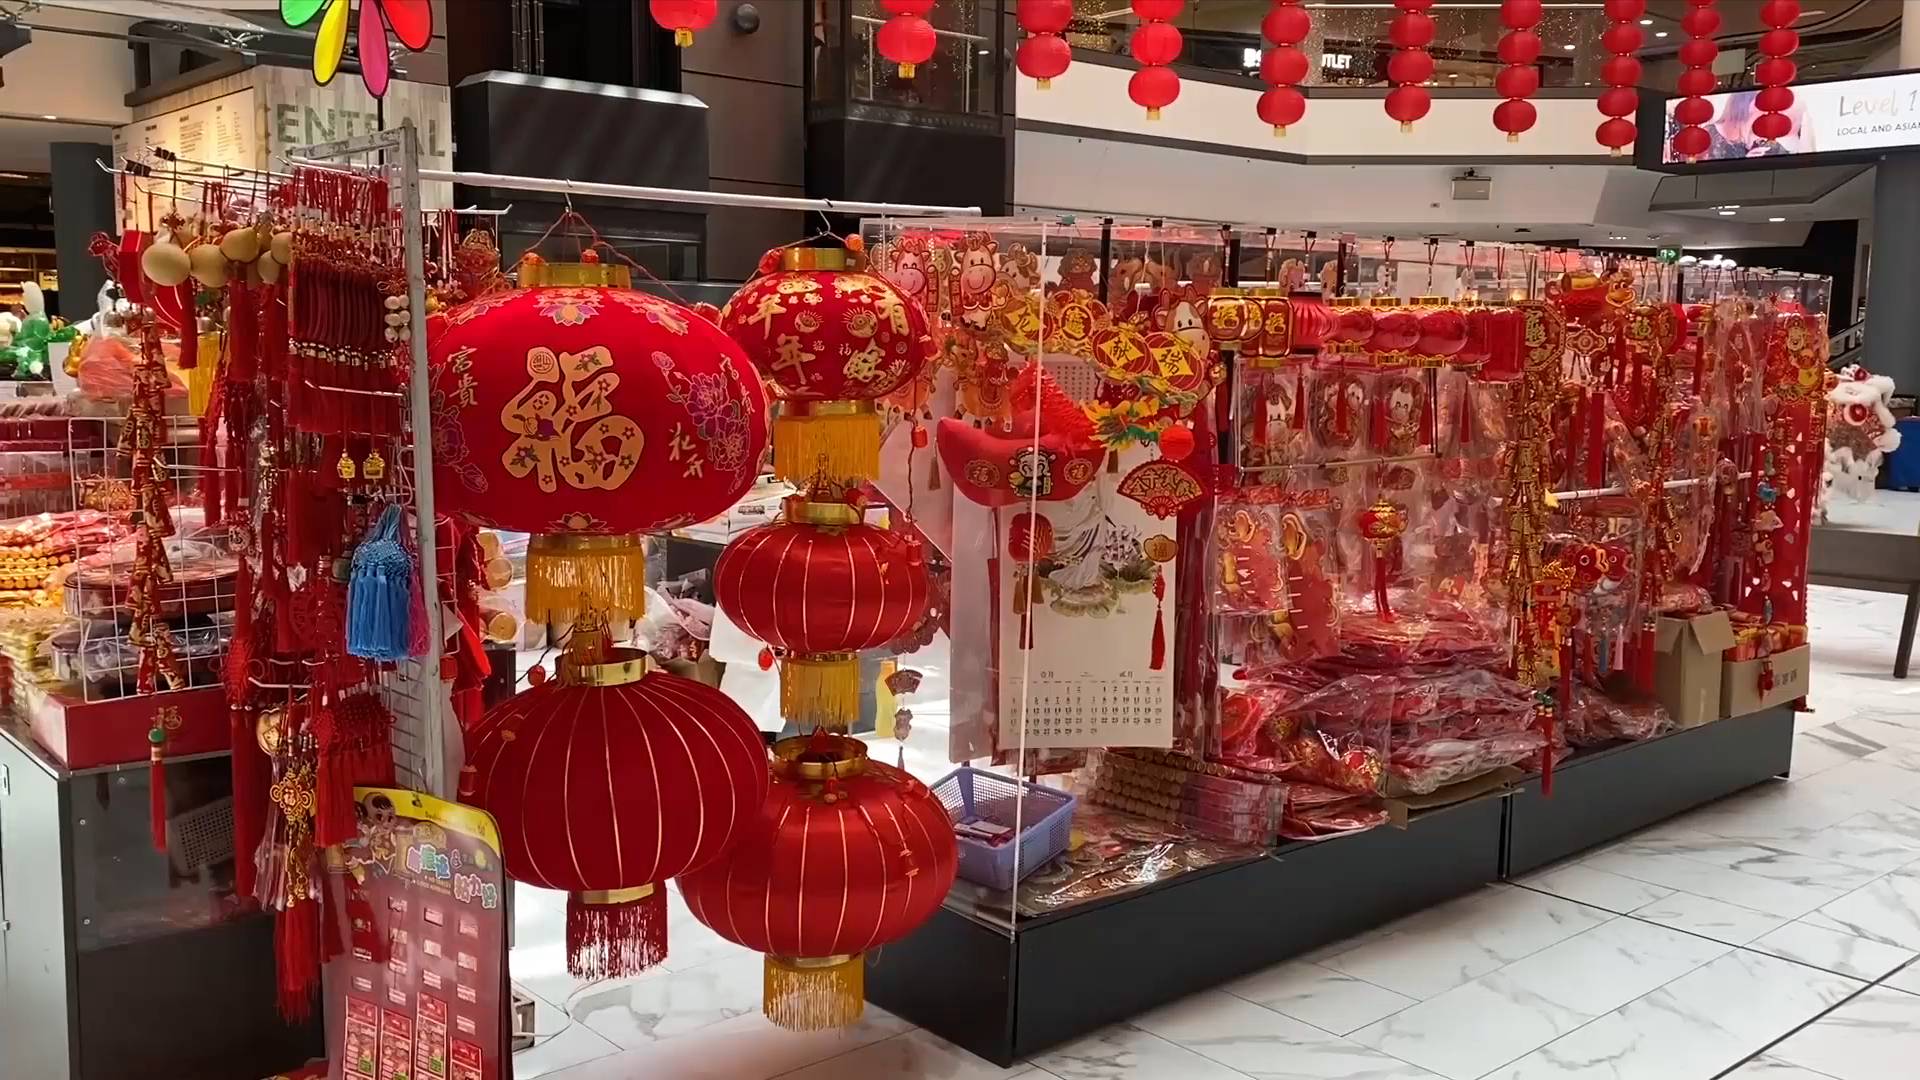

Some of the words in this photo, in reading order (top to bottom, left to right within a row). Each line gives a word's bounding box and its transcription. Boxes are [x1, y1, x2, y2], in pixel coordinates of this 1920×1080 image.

[1840, 88, 1898, 117] Level
[1908, 89, 1918, 111] 1
[277, 104, 446, 157] ENTL
[1837, 126, 1868, 136] LOCAL
[1871, 124, 1892, 133] AND
[1895, 121, 1920, 131] ASIA
[1110, 337, 1133, 362] 献
[1159, 349, 1183, 375] 瑞
[501, 345, 644, 493] 福
